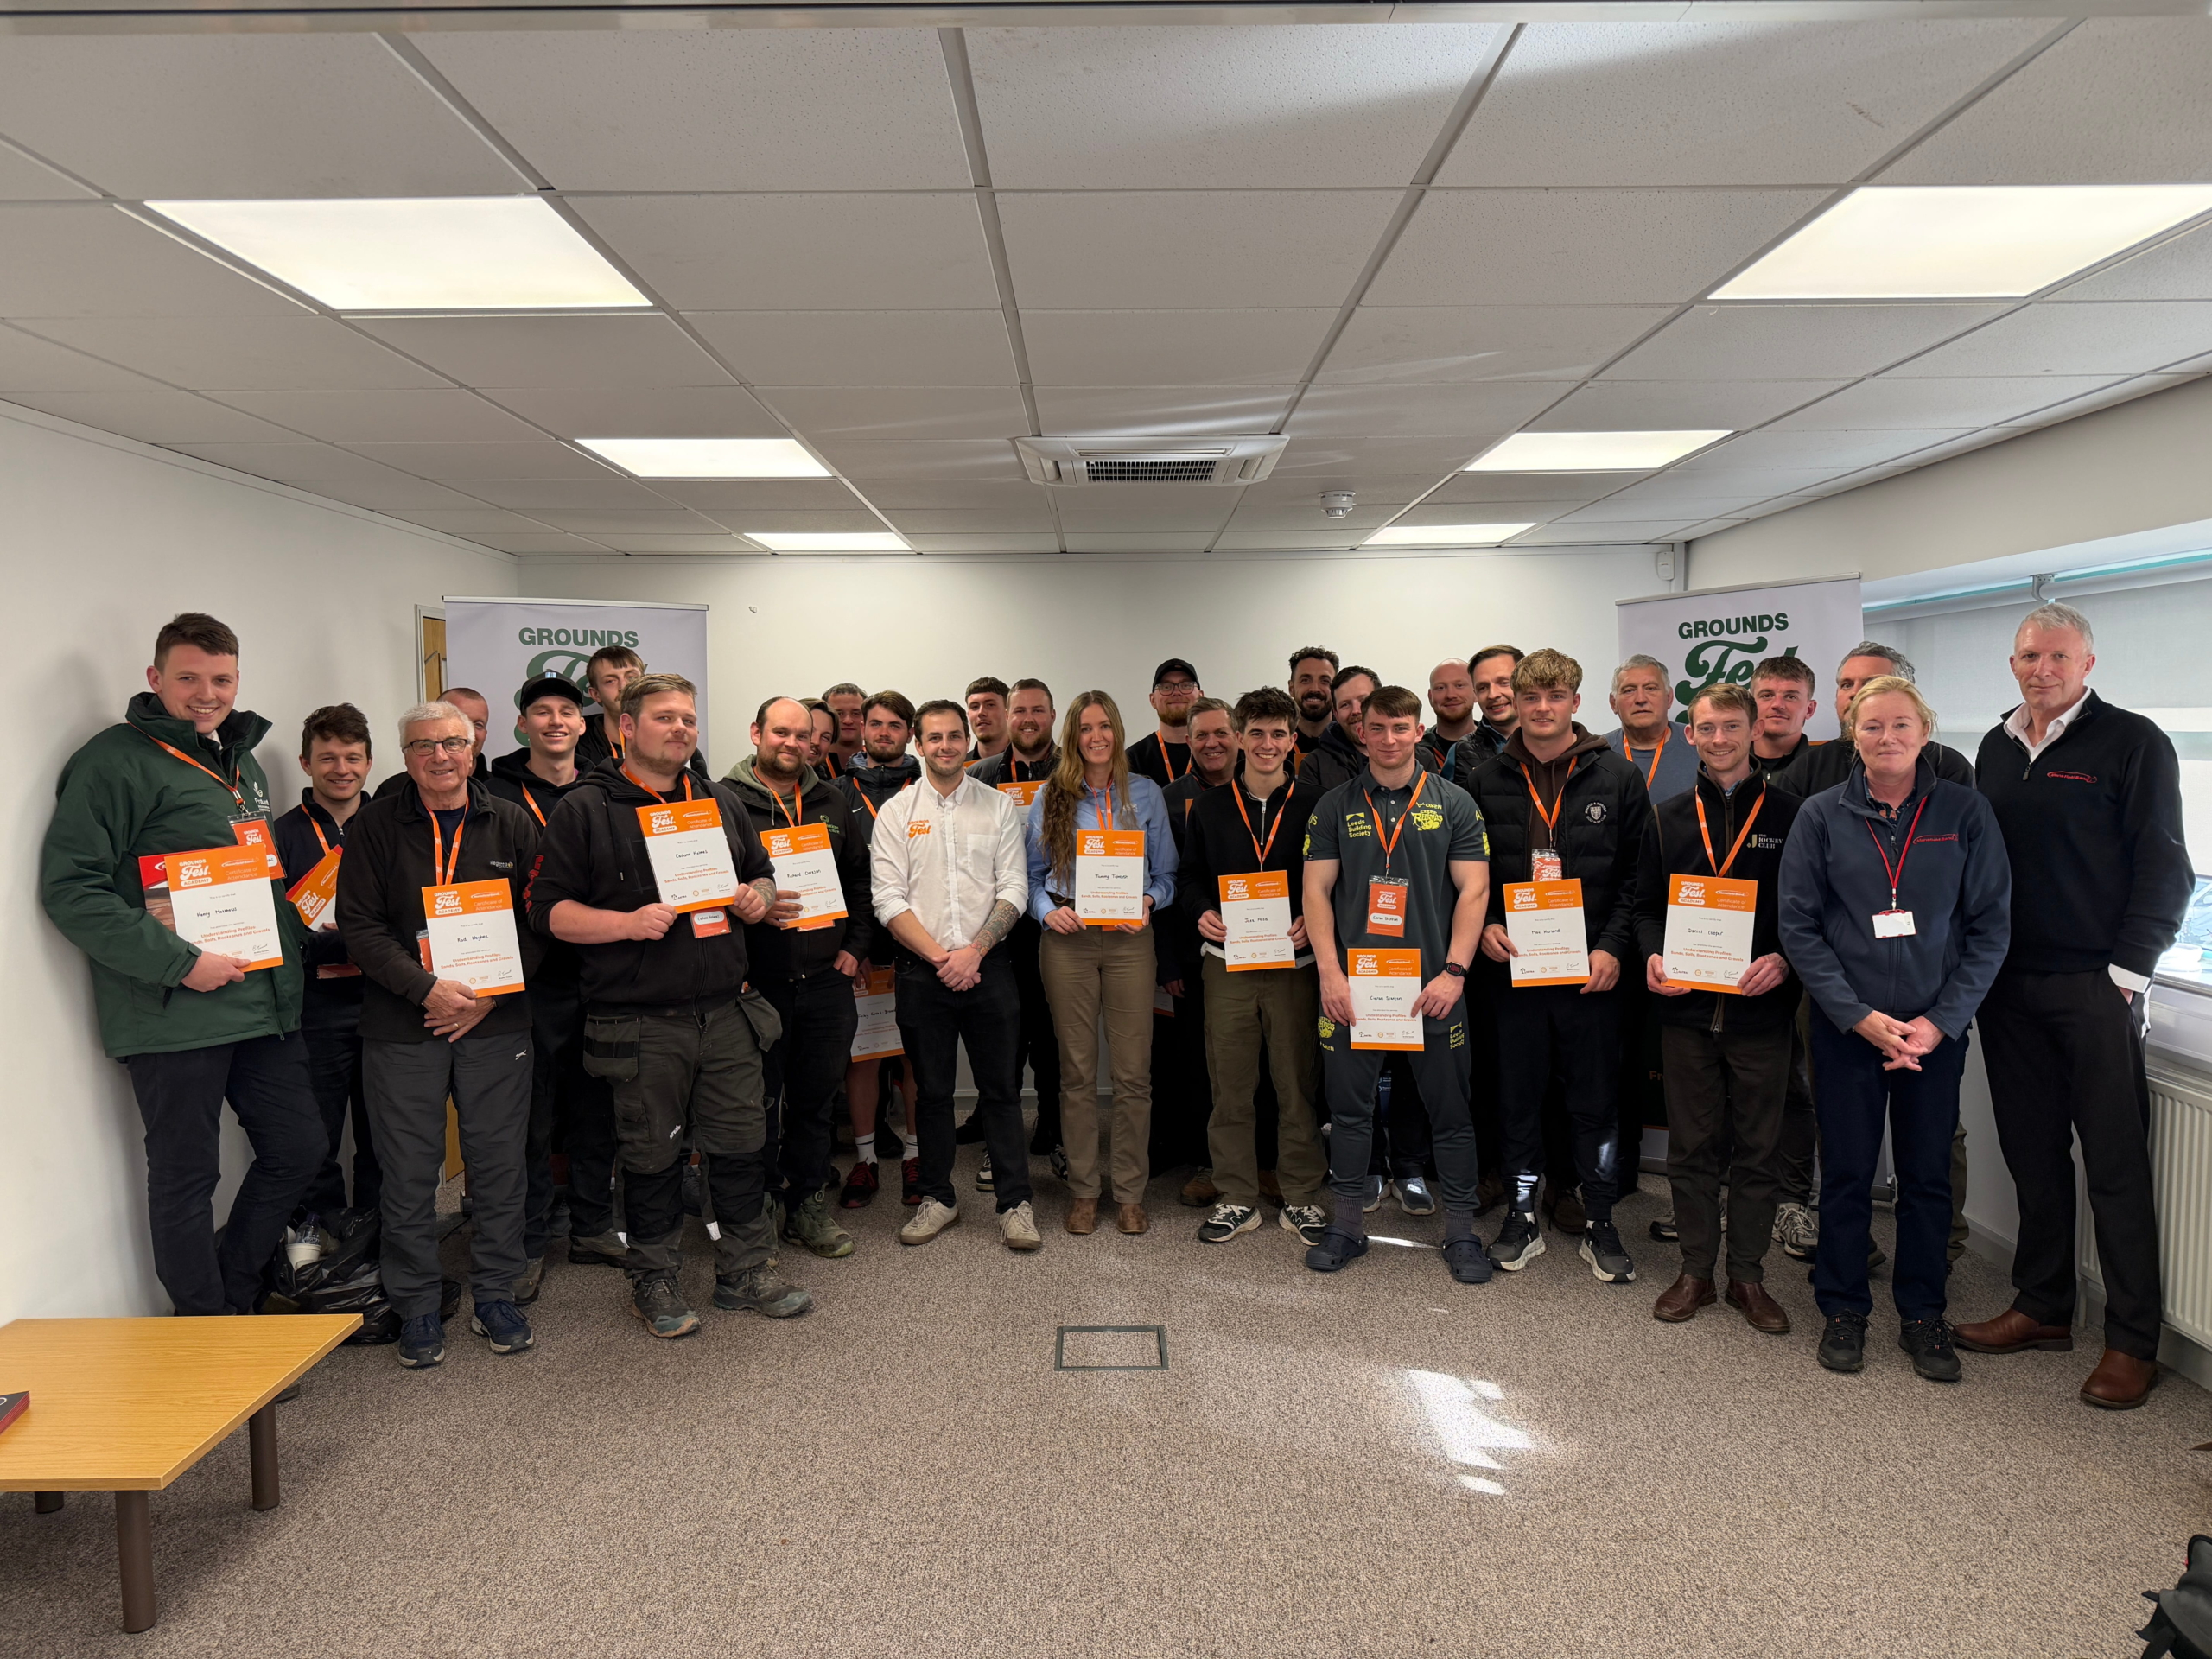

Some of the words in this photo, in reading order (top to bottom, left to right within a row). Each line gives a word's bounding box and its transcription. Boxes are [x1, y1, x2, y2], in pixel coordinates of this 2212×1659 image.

[1678, 613, 1789, 639] GROUNDS
[518, 627, 639, 648] GROUNDS
[651, 814, 675, 828] Fest
[909, 823, 931, 838] Fest
[179, 863, 210, 880] Fest
[1513, 892, 1536, 904] Fest
[1678, 885, 1705, 898] Fest
[434, 894, 461, 909] Fest
[1377, 894, 1396, 904] Fest
[200, 929, 237, 938] Understanding
